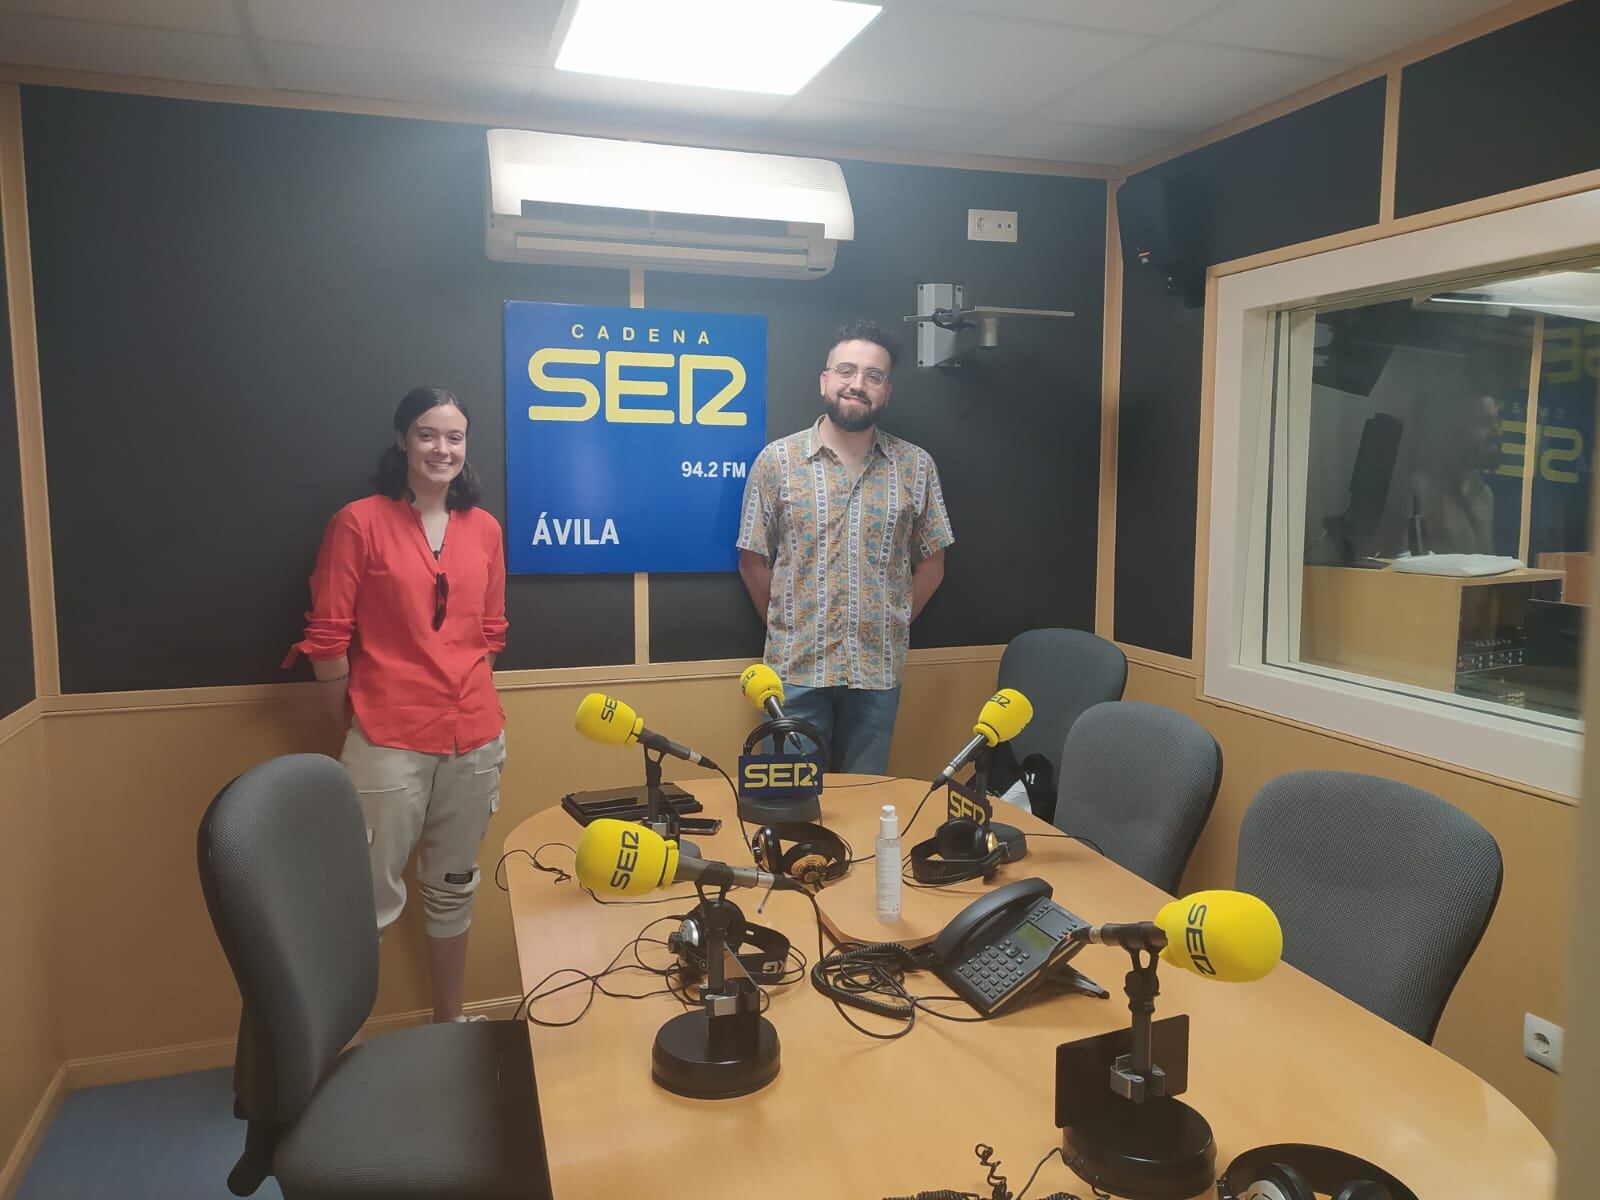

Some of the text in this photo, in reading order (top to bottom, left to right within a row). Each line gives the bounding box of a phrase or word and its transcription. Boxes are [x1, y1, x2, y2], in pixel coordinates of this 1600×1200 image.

[571, 324, 709, 344] CADENA
[528, 348, 747, 425] SER
[681, 460, 746, 479] 94.2 FM
[532, 511, 620, 546] ÁVILA
[600, 695, 618, 724] SE
[744, 762, 818, 789] SER
[610, 830, 640, 890] SER
[1185, 902, 1217, 976] SER
